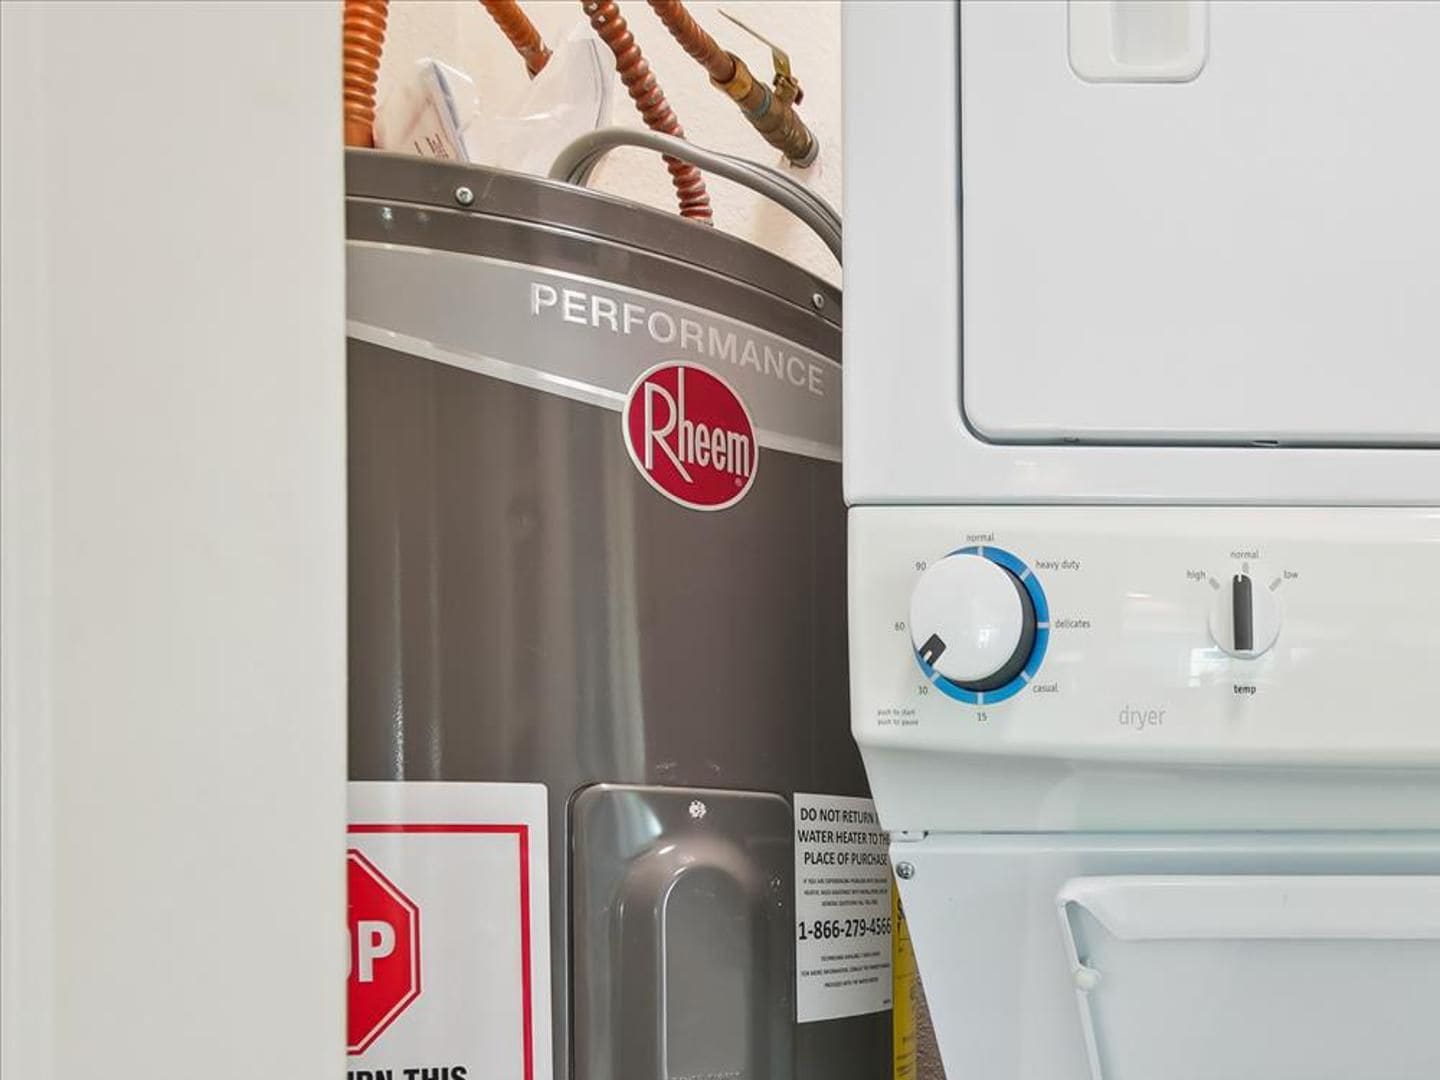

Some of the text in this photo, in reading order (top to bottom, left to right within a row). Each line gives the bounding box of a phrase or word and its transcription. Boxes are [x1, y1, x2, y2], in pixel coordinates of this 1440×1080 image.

[530, 282, 826, 397] PERFORMANCE
[643, 366, 751, 483] Rheem
[966, 533, 995, 543] normal
[1230, 549, 1260, 560] normal
[915, 561, 927, 572] 90
[1035, 560, 1081, 571] heavy duty
[1186, 569, 1206, 582] high
[1284, 569, 1299, 580] low
[894, 621, 906, 632] 60
[1055, 619, 1091, 629] delicates
[1033, 683, 1059, 693] casual
[1233, 684, 1257, 696] temp
[976, 711, 988, 722] 15
[1118, 704, 1167, 731] dryer
[800, 807, 874, 824] DO NOT RETURN
[798, 829, 834, 844] WATER
[836, 831, 868, 845] HEATER
[869, 833, 878, 846] TO
[804, 851, 888, 867] PLACE OF PURCHASE
[799, 917, 892, 941] 1-866-279-4566
